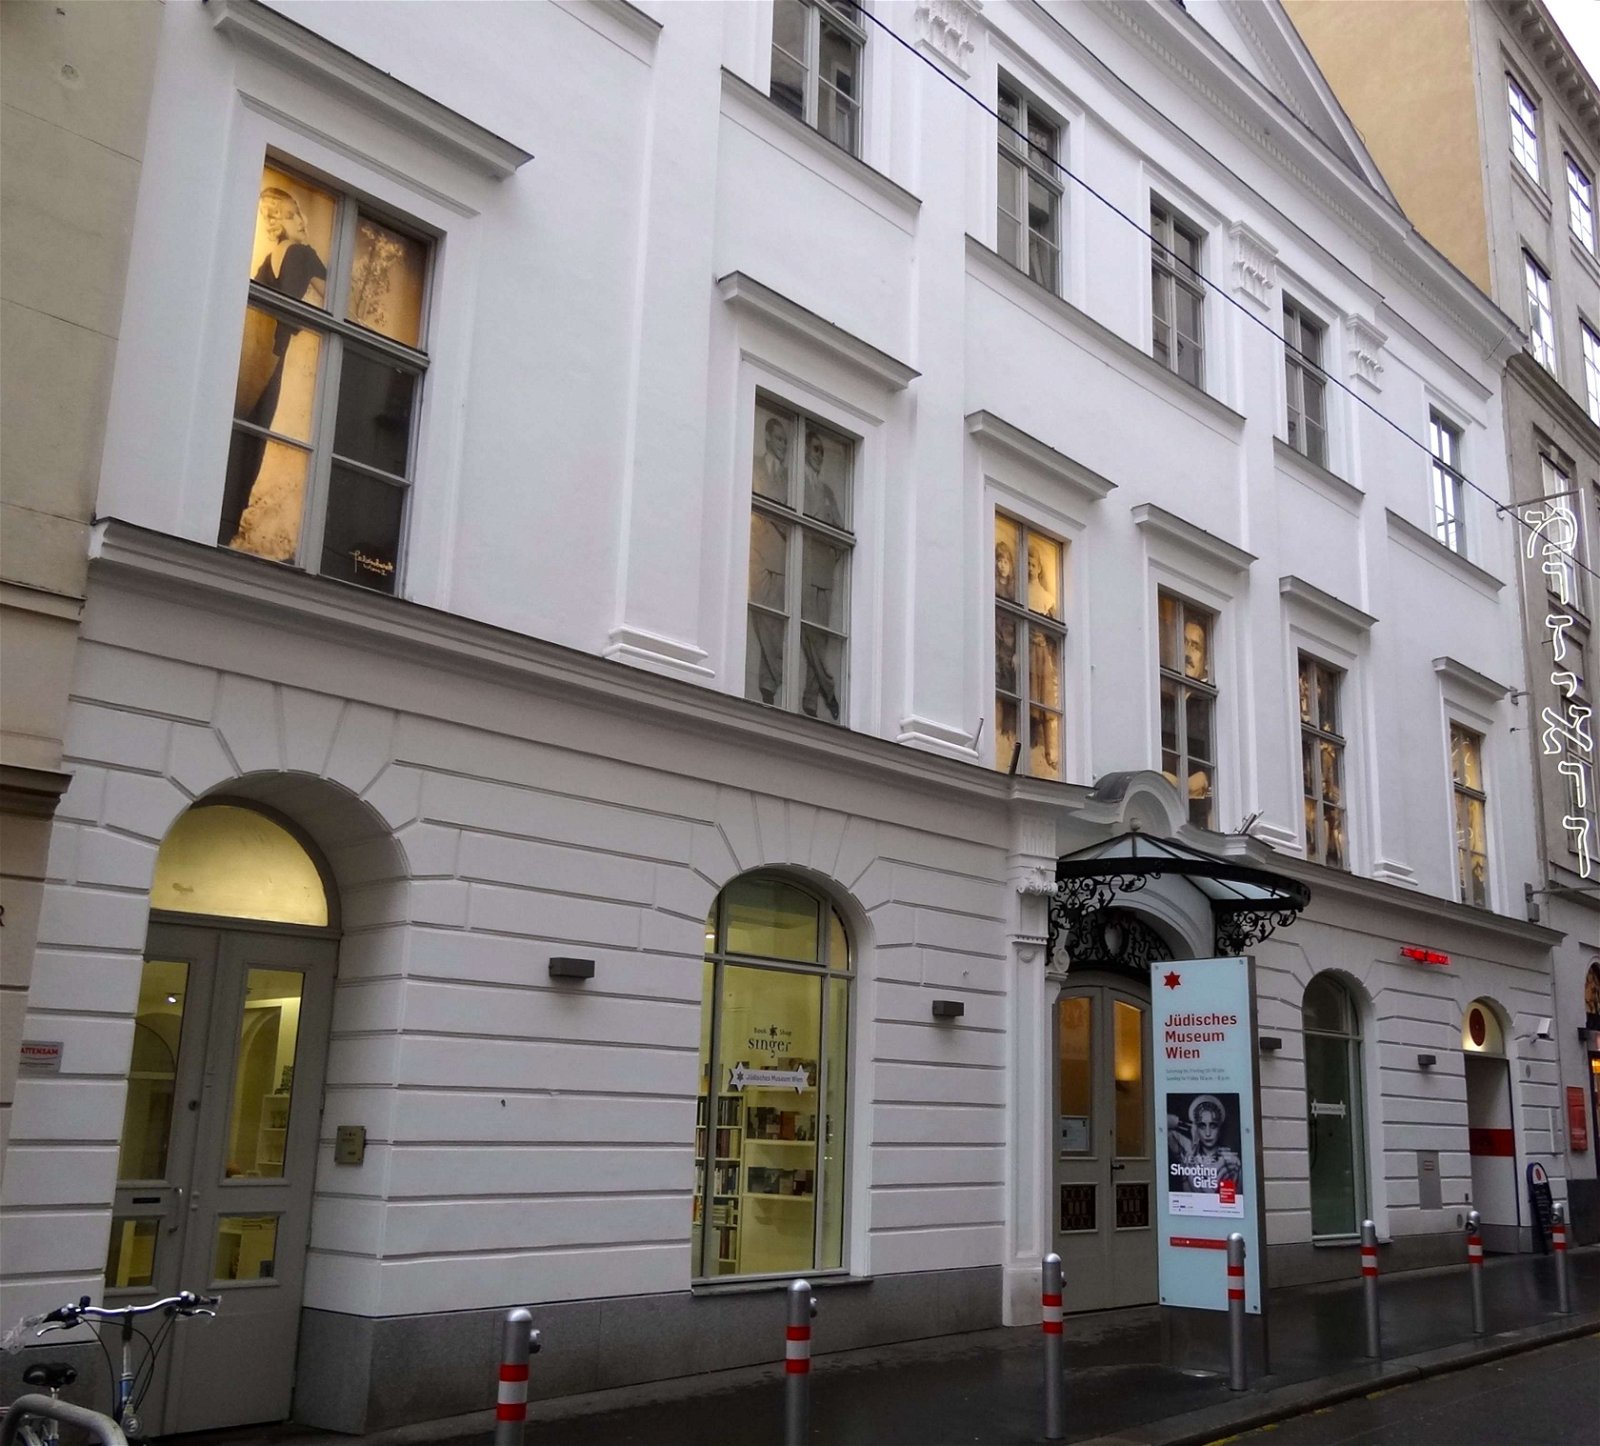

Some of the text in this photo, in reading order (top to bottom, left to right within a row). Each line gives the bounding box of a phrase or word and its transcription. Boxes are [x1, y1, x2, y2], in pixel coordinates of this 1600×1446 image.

[1164, 1013, 1237, 1027] Jüdisches
[1165, 1030, 1225, 1043] Museum
[748, 1038, 792, 1058] singer
[1165, 1046, 1200, 1059] Wien
[1170, 1163, 1218, 1178] Shooting
[1193, 1176, 1218, 1189] Girls
